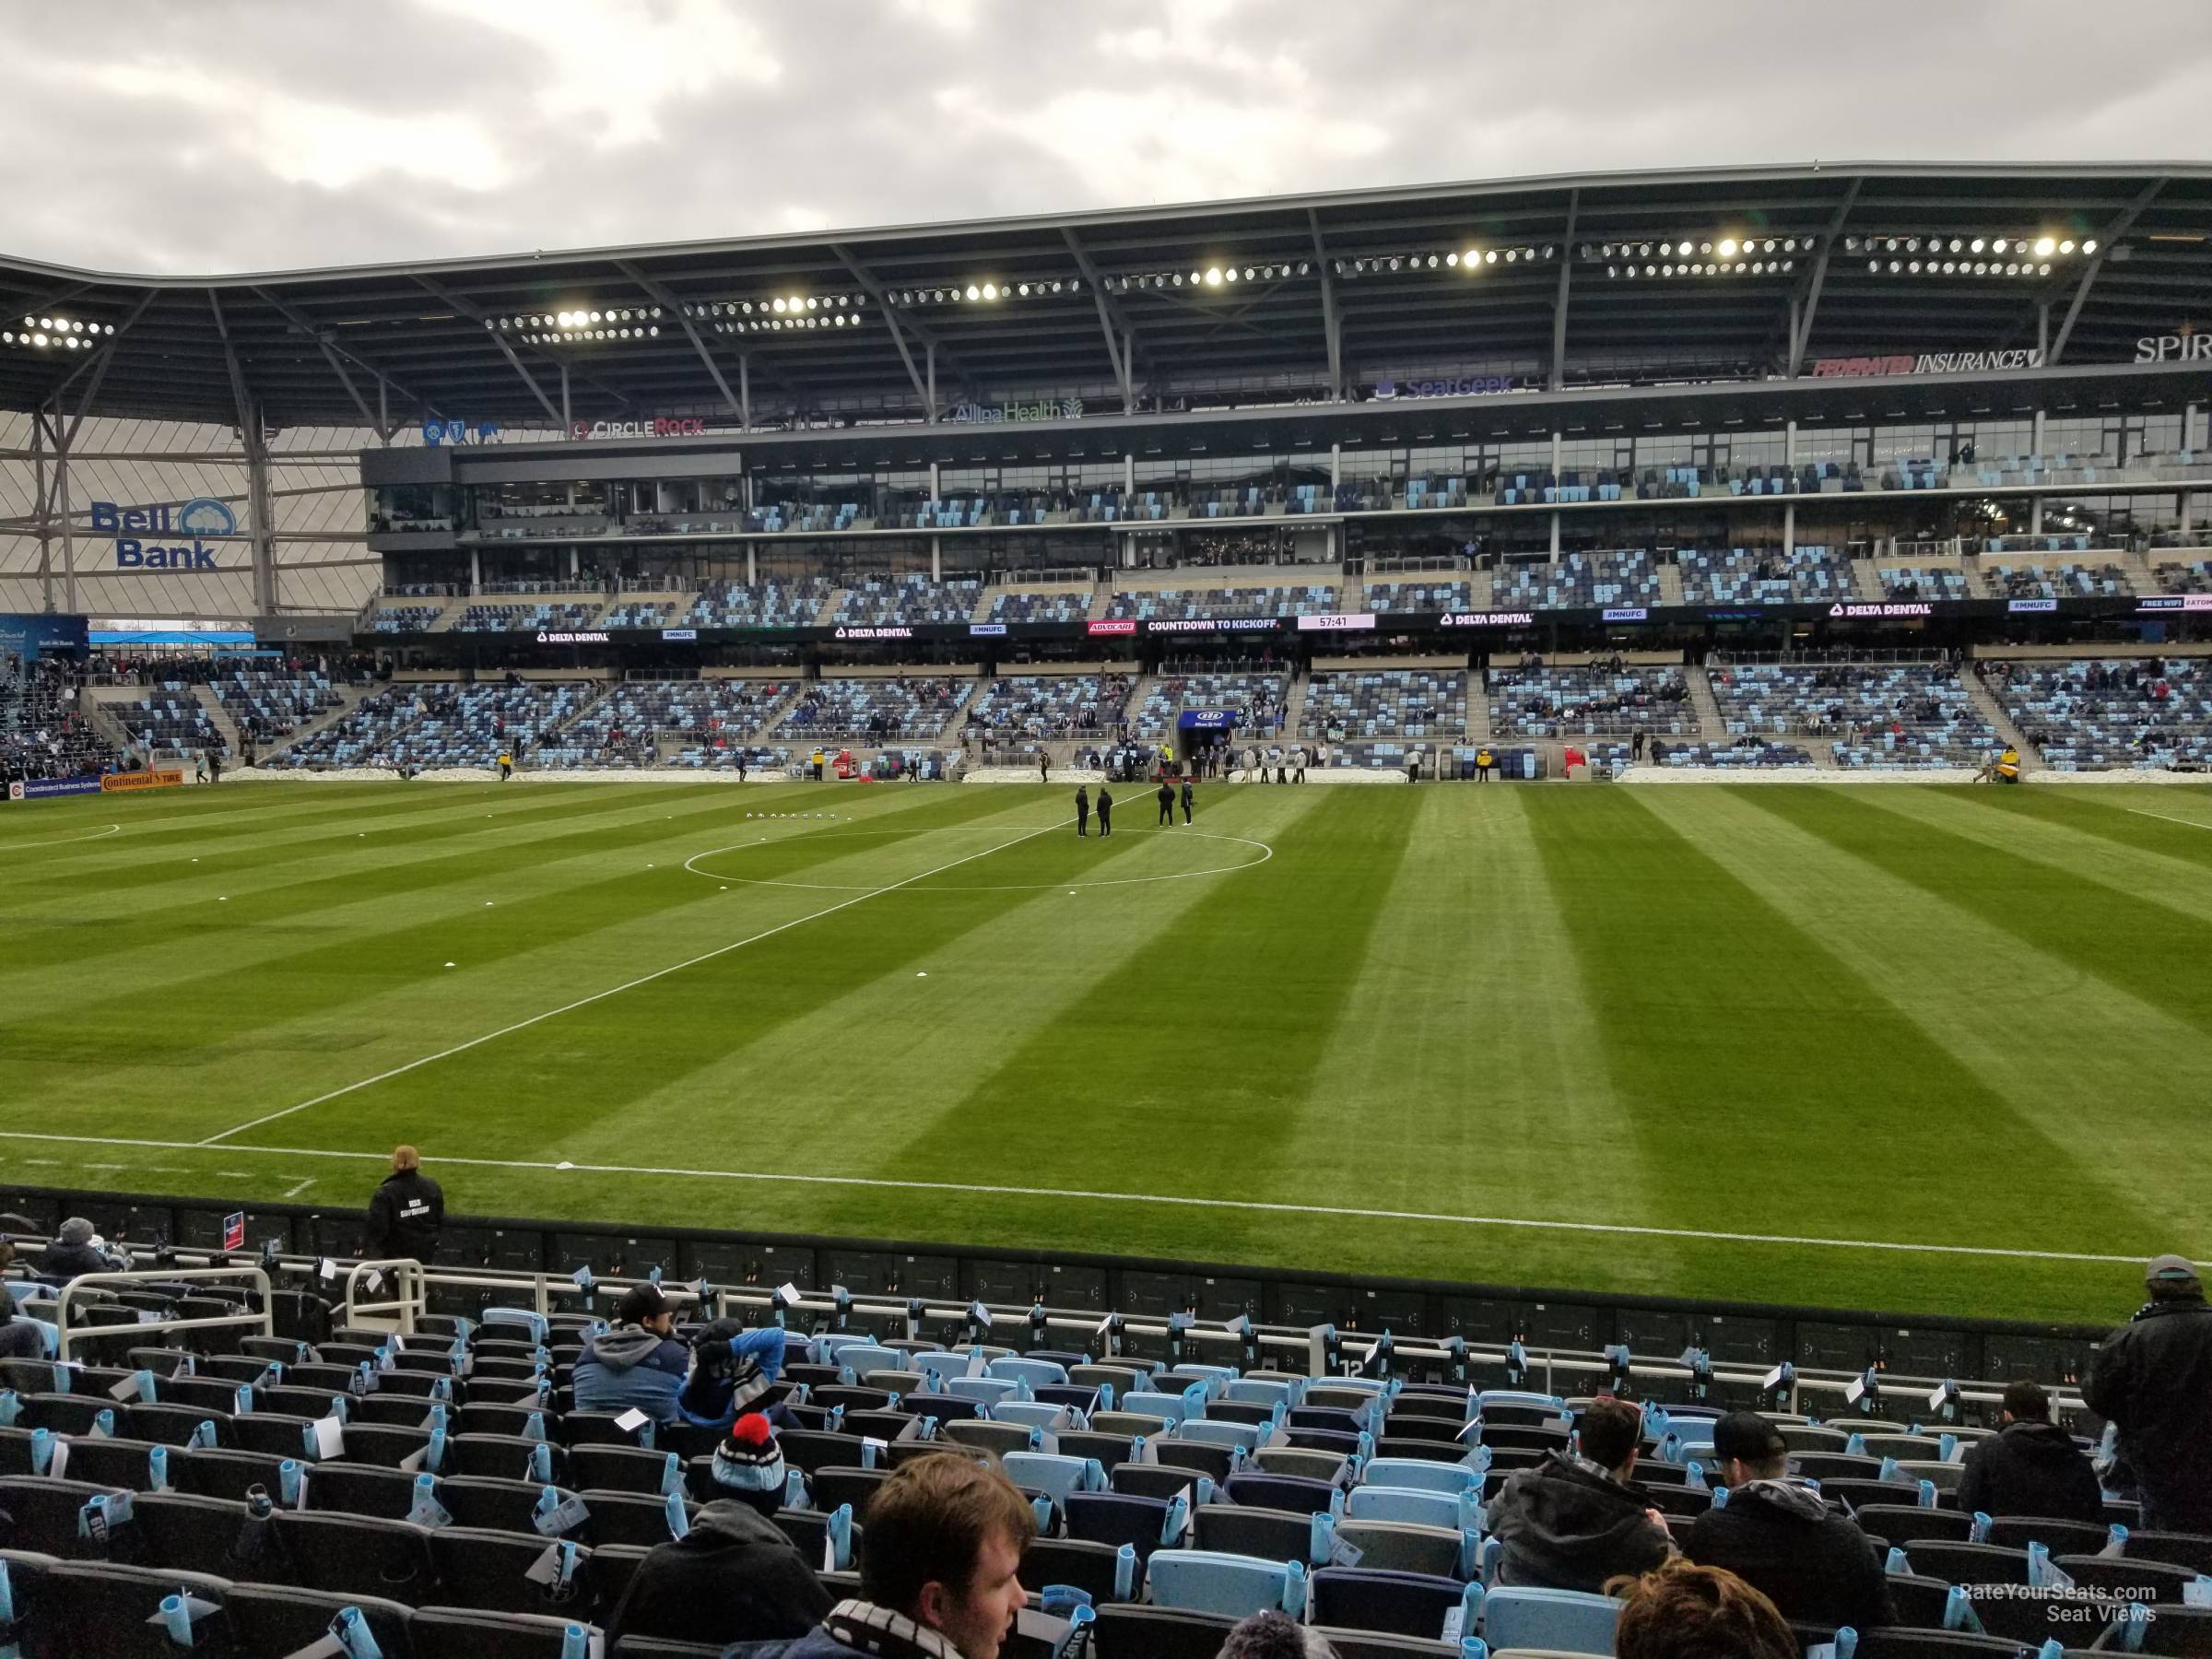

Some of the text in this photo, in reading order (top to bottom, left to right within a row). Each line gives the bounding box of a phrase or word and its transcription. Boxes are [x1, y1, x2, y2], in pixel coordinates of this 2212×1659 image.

[1813, 349, 2028, 377] FEDERATED INSURANCE
[1406, 375, 1513, 398] SeatGeek
[90, 501, 171, 532] Bell
[116, 539, 218, 569] Bank
[2014, 601, 2051, 609] #MNUFC
[2142, 599, 2163, 607] FREE
[1607, 610, 1642, 618] #MNUFC
[1846, 604, 1931, 616] DELTA DENTAL
[1147, 619, 1215, 631] COUNTDOWN
[1217, 620, 1230, 629] TO
[1320, 617, 1347, 628] 57:41
[1455, 613, 1532, 625] DELTA DENTAL
[848, 628, 912, 638] DELTA DENTAL
[1089, 622, 1135, 632] ADVOCARE
[549, 632, 609, 642] DELTA DENTAL
[103, 773, 181, 791] Continental TIRE
[1339, 1359, 1364, 1378] 12
